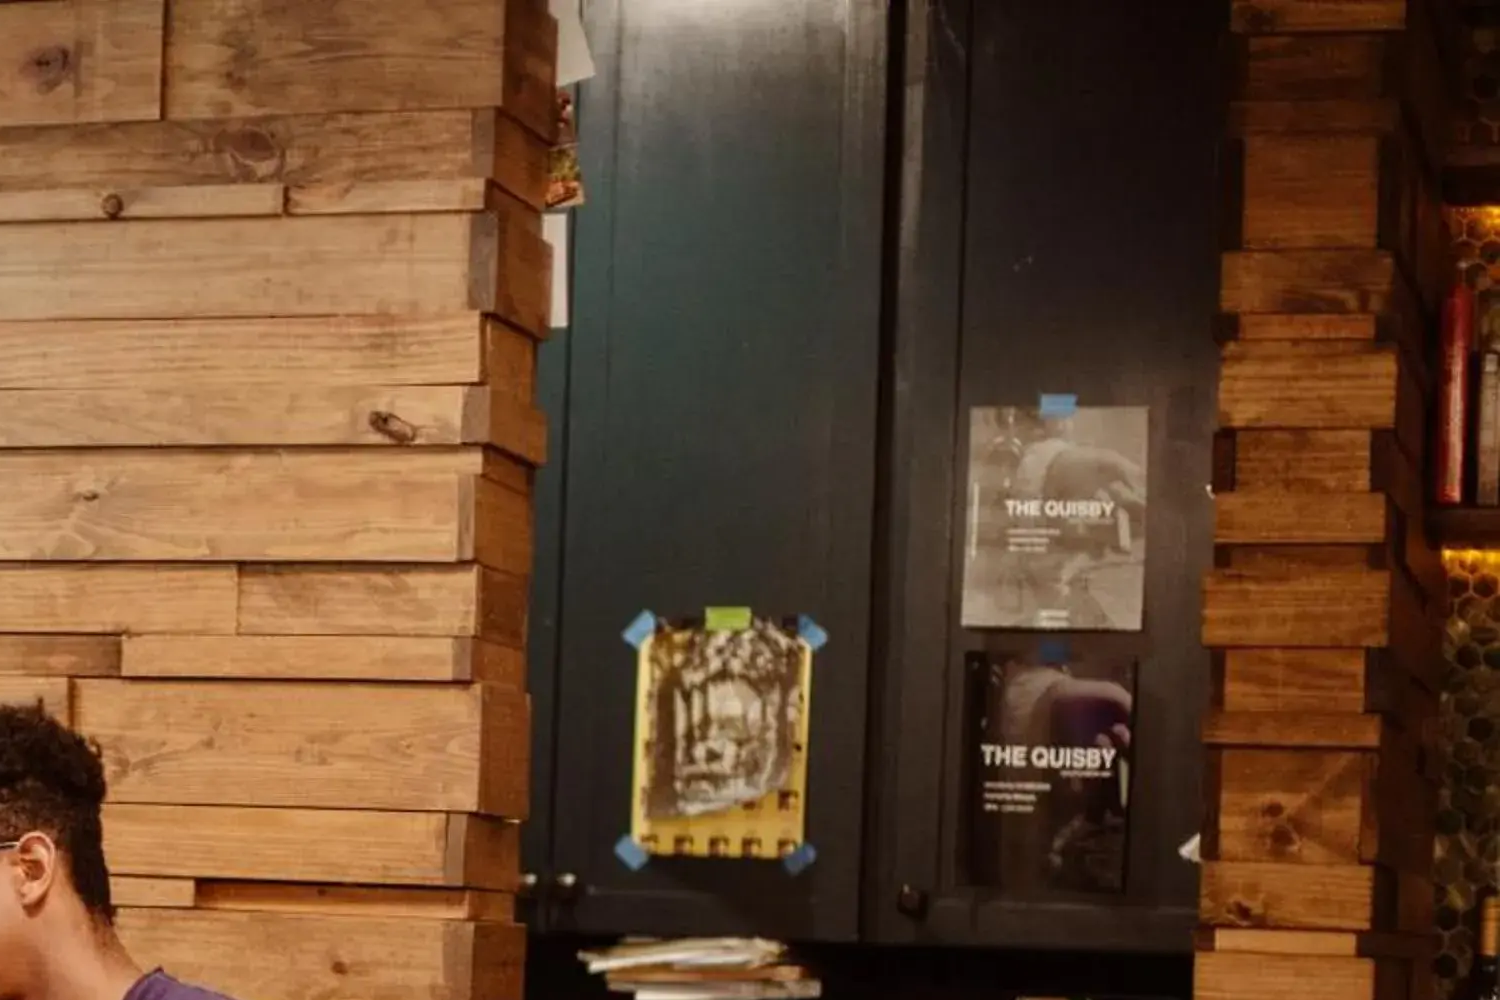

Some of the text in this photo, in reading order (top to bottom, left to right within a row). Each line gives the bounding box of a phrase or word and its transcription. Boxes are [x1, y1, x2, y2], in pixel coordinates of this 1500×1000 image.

[1004, 499, 1115, 518] THE QUISBY
[980, 743, 1117, 769] THE QUISBY
